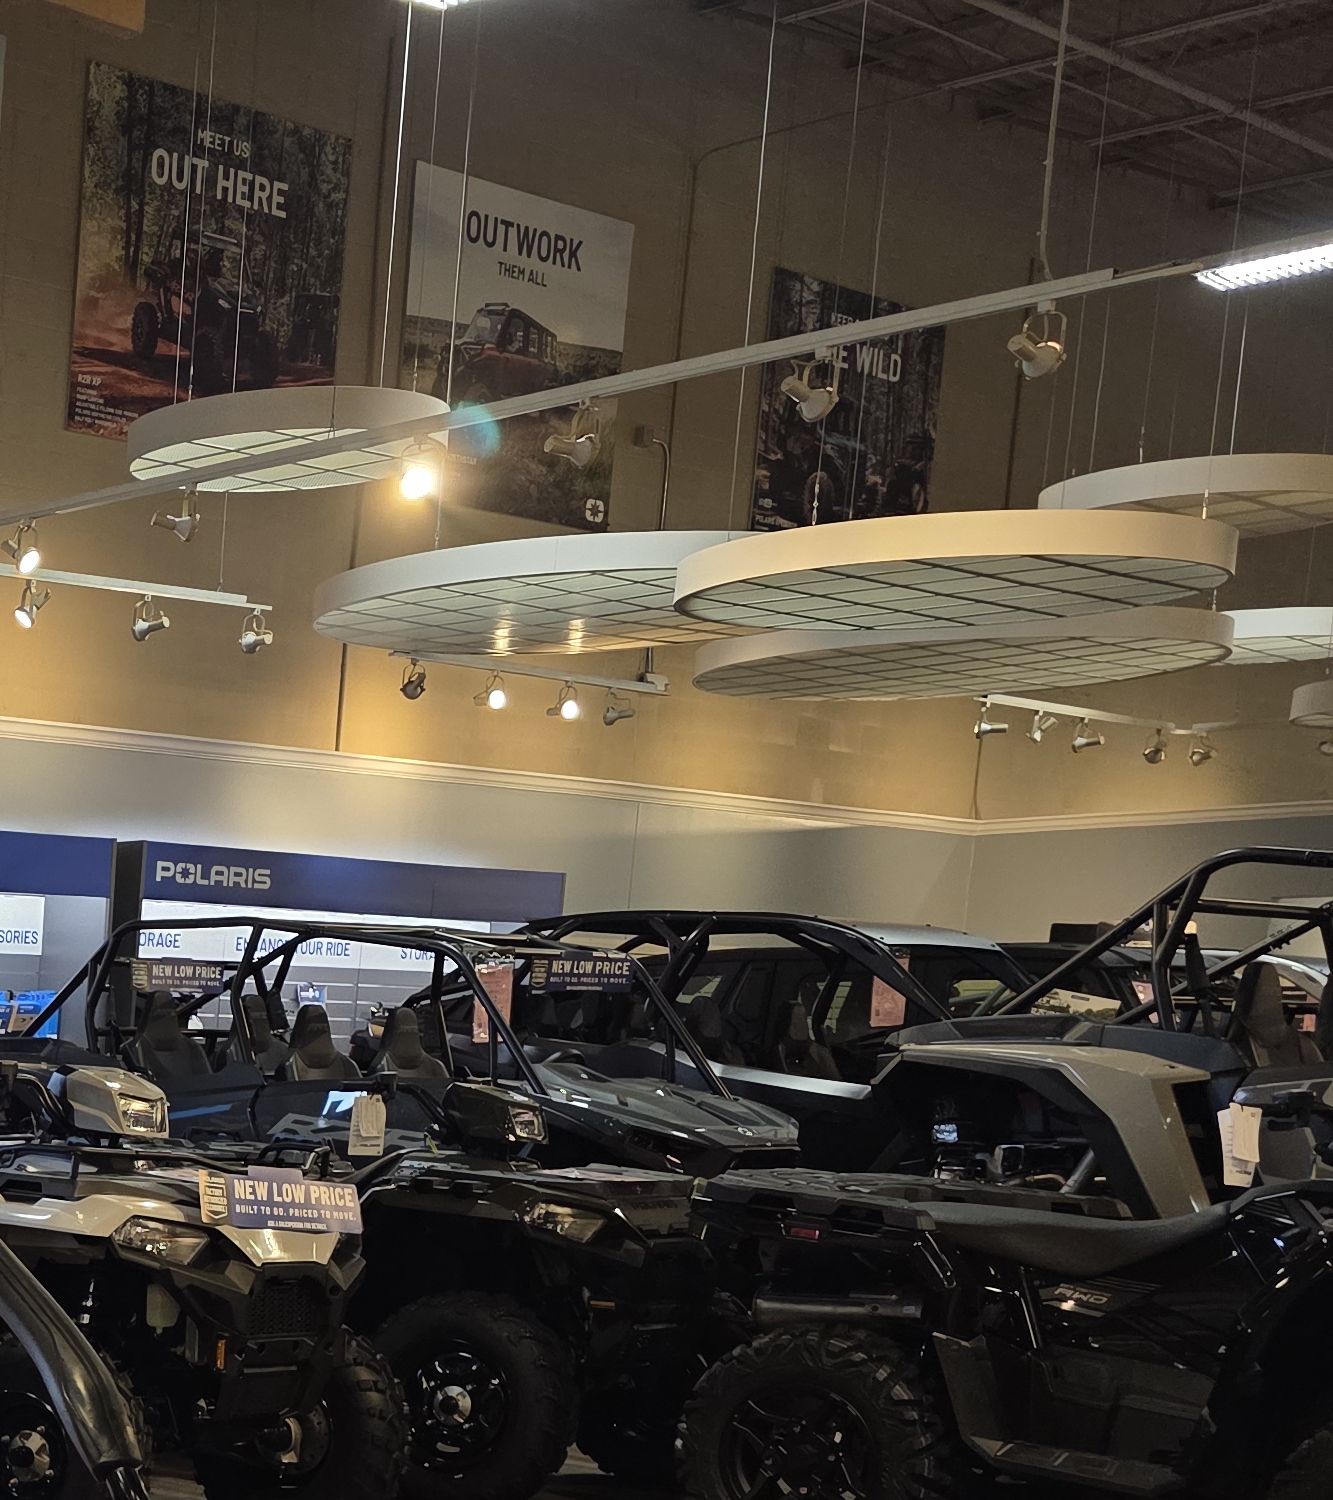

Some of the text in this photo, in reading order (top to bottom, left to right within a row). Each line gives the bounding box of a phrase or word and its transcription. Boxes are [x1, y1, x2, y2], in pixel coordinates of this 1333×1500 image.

[197, 128, 251, 158] MEET US
[151, 148, 289, 219] OUT HERE
[466, 210, 583, 272] OUTWORK
[498, 261, 547, 287] THEM ALL
[856, 343, 902, 382] WILD
[156, 860, 271, 889] POLARIS
[139, 932, 182, 948] ORAGE
[295, 941, 324, 955] OUR
[325, 942, 351, 957] RIDE
[152, 964, 172, 977] NEW
[174, 965, 193, 978] LOW
[195, 966, 221, 979] PRICE
[552, 960, 572, 973] NEW
[573, 961, 593, 974] LOW
[595, 961, 630, 975] PRICE
[234, 1179, 355, 1208] NEW LOW PRICE
[260, 1205, 271, 1215] TO
[289, 1208, 318, 1219] PRICED
[320, 1209, 331, 1219] TO
[332, 1210, 356, 1221] MOVE.
